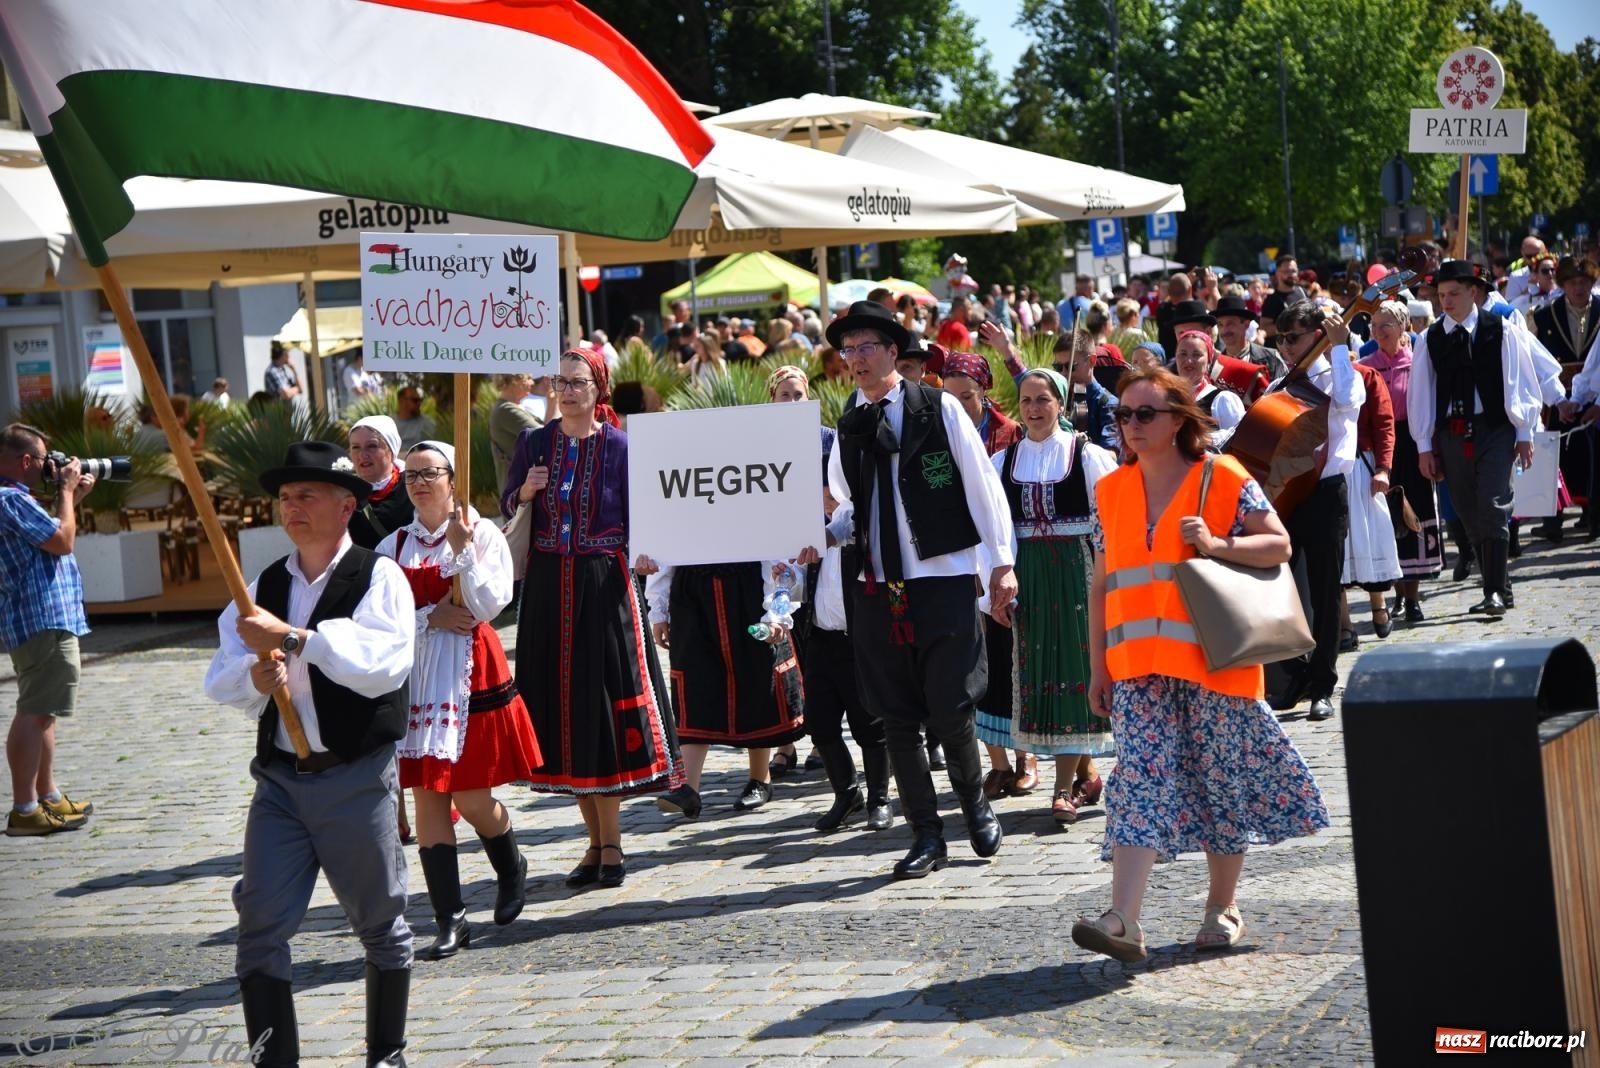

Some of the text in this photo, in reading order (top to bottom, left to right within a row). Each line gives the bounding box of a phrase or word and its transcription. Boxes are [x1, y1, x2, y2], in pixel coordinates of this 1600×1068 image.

[1425, 117, 1509, 138] PATRIA
[1444, 138, 1488, 147] KATOWICE
[318, 199, 450, 239] gelatopiu
[847, 187, 912, 223] gelatopiu
[1096, 217, 1117, 247] P
[1152, 212, 1170, 237] P
[389, 247, 495, 280] Hungary
[371, 340, 552, 367] Folk Dance Group
[658, 461, 793, 505] WĘGRY
